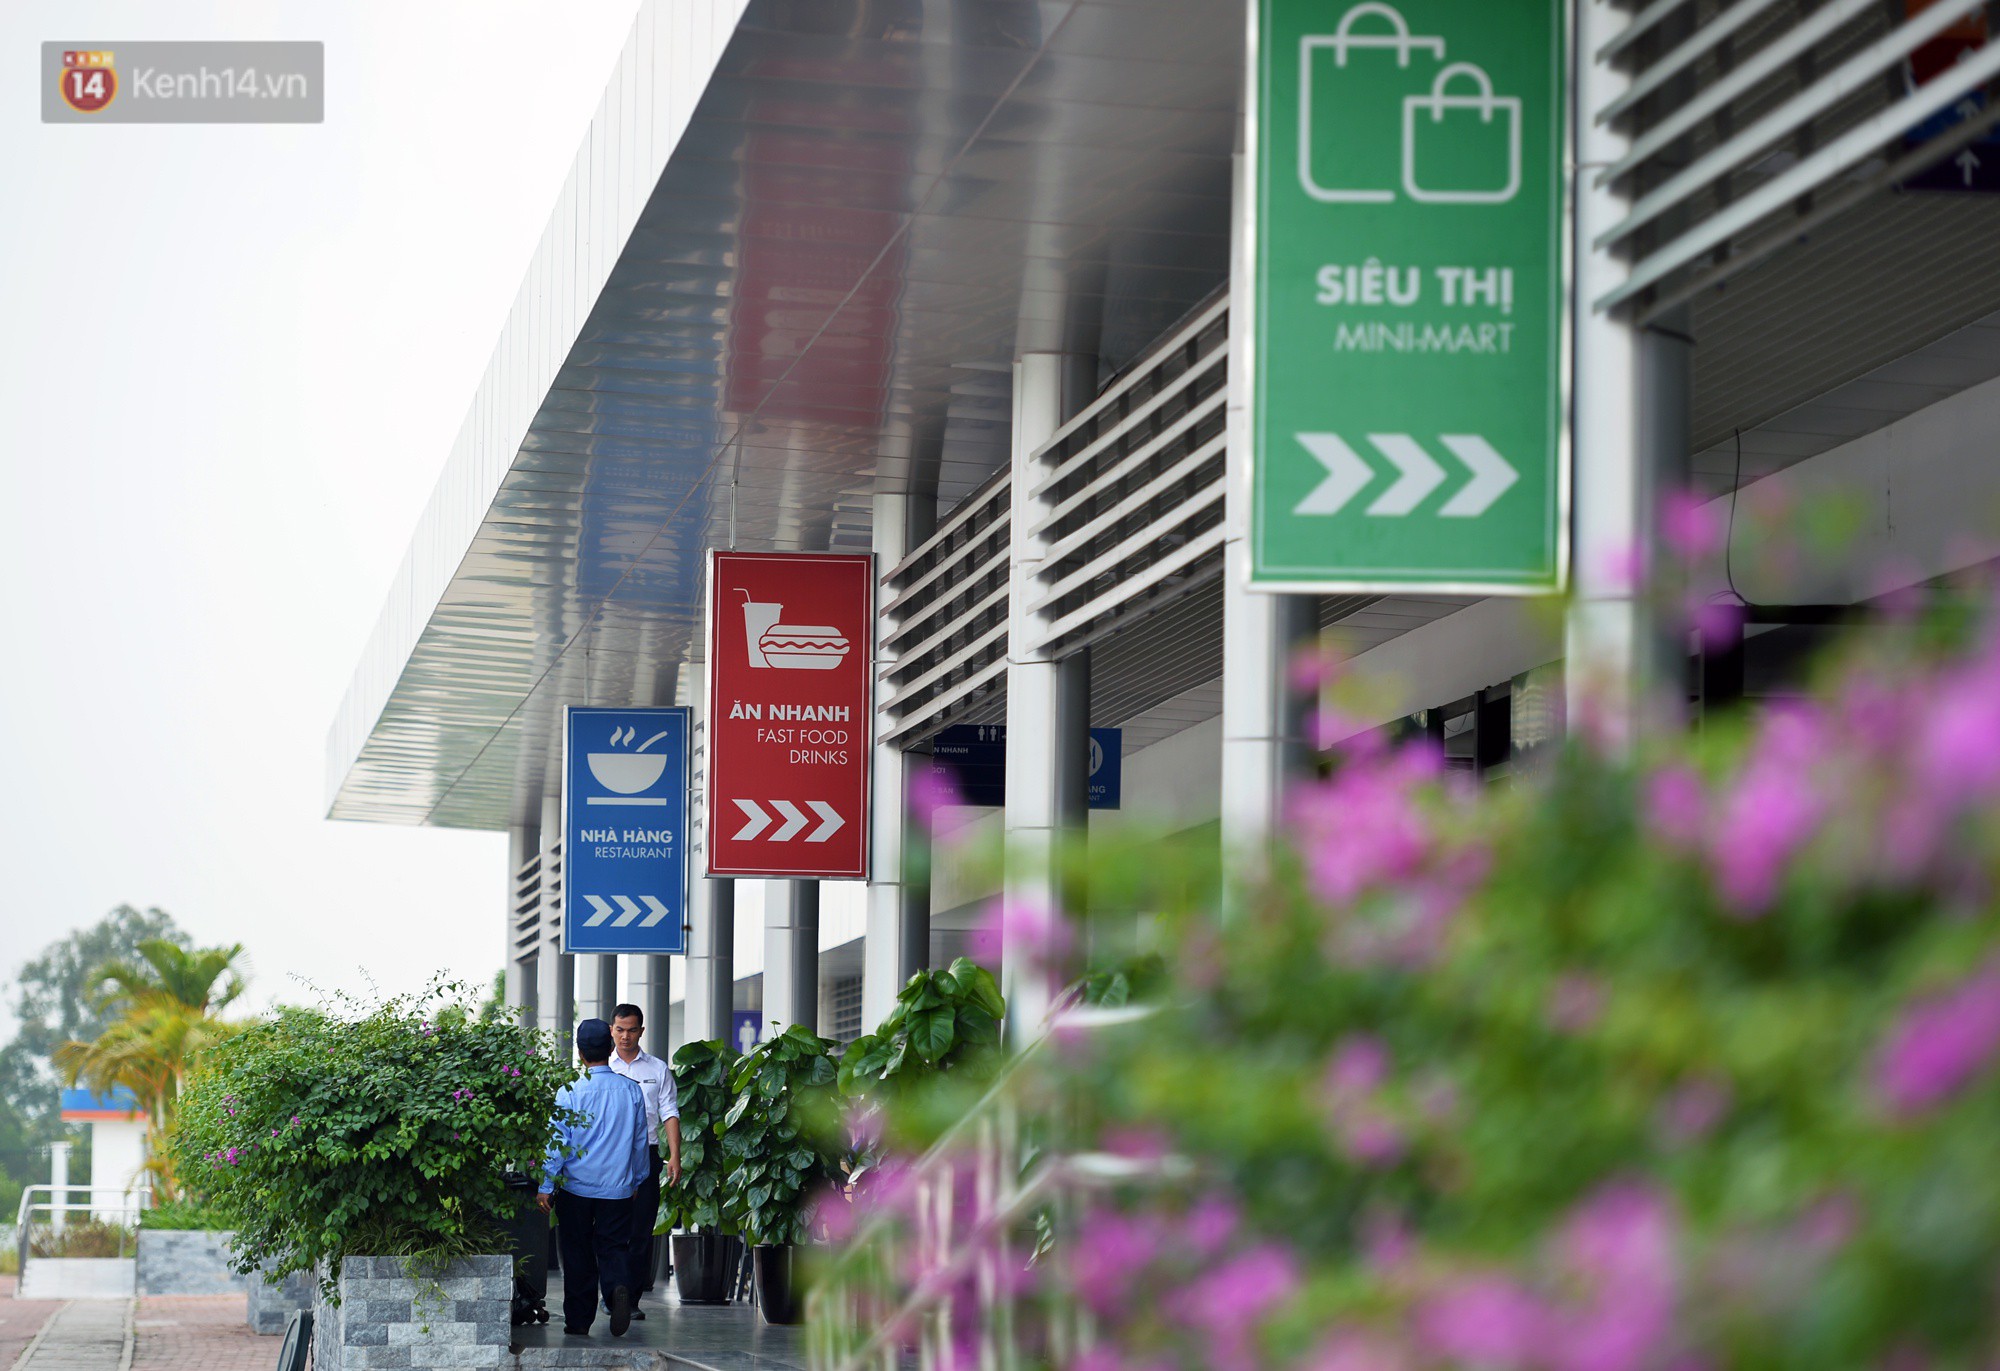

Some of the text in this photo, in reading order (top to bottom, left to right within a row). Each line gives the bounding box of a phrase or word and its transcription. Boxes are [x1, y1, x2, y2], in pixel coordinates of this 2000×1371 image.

[1315, 256, 1514, 315] SIÊU THỊ
[1333, 321, 1515, 353] MINI-MART
[729, 700, 850, 722] ĂN NHANH
[757, 728, 848, 745] FAST FOOD
[789, 749, 848, 765] DRINKS
[580, 827, 673, 844] NHÀ HÀNG
[594, 846, 673, 859] RESTAURANT
